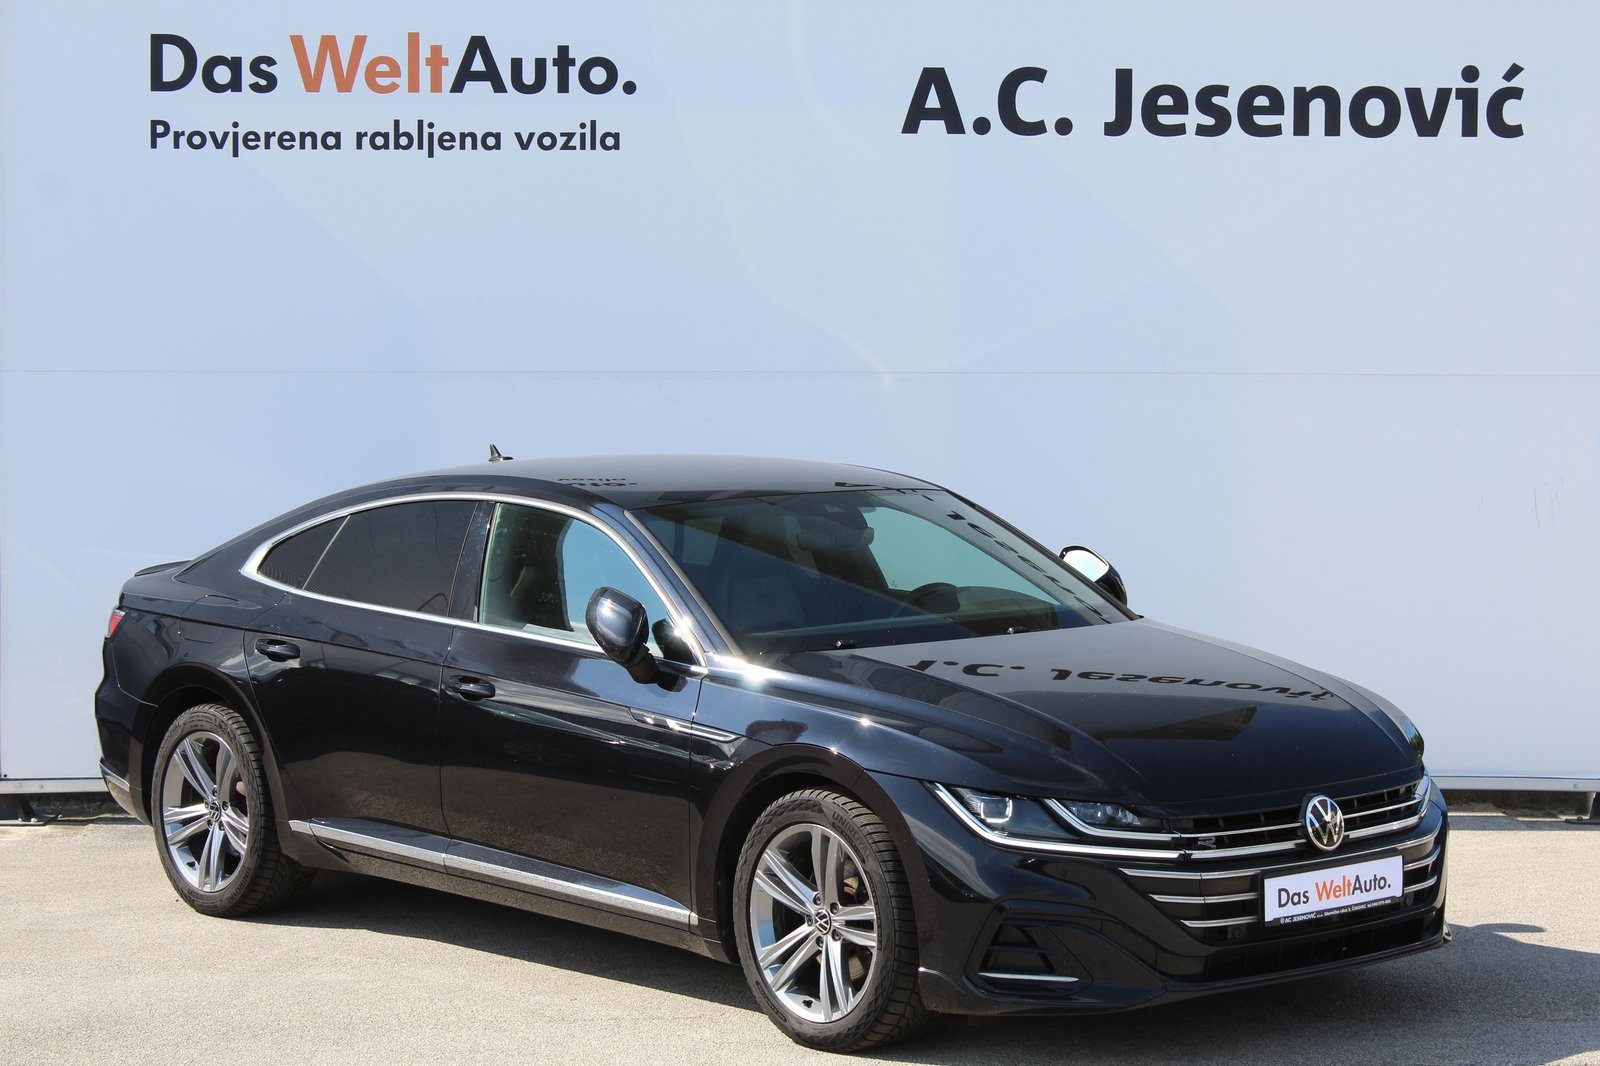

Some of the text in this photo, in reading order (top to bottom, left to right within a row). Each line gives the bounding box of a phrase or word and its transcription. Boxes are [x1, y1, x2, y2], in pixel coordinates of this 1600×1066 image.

[150, 31, 637, 96] Das WeltAuto.
[901, 62, 1525, 139] A.C. Jesenović
[150, 118, 621, 159] Provjerena rabljena vozila
[227, 867, 252, 904] UNIROYAL
[1277, 873, 1392, 909] Das WeltAuto.
